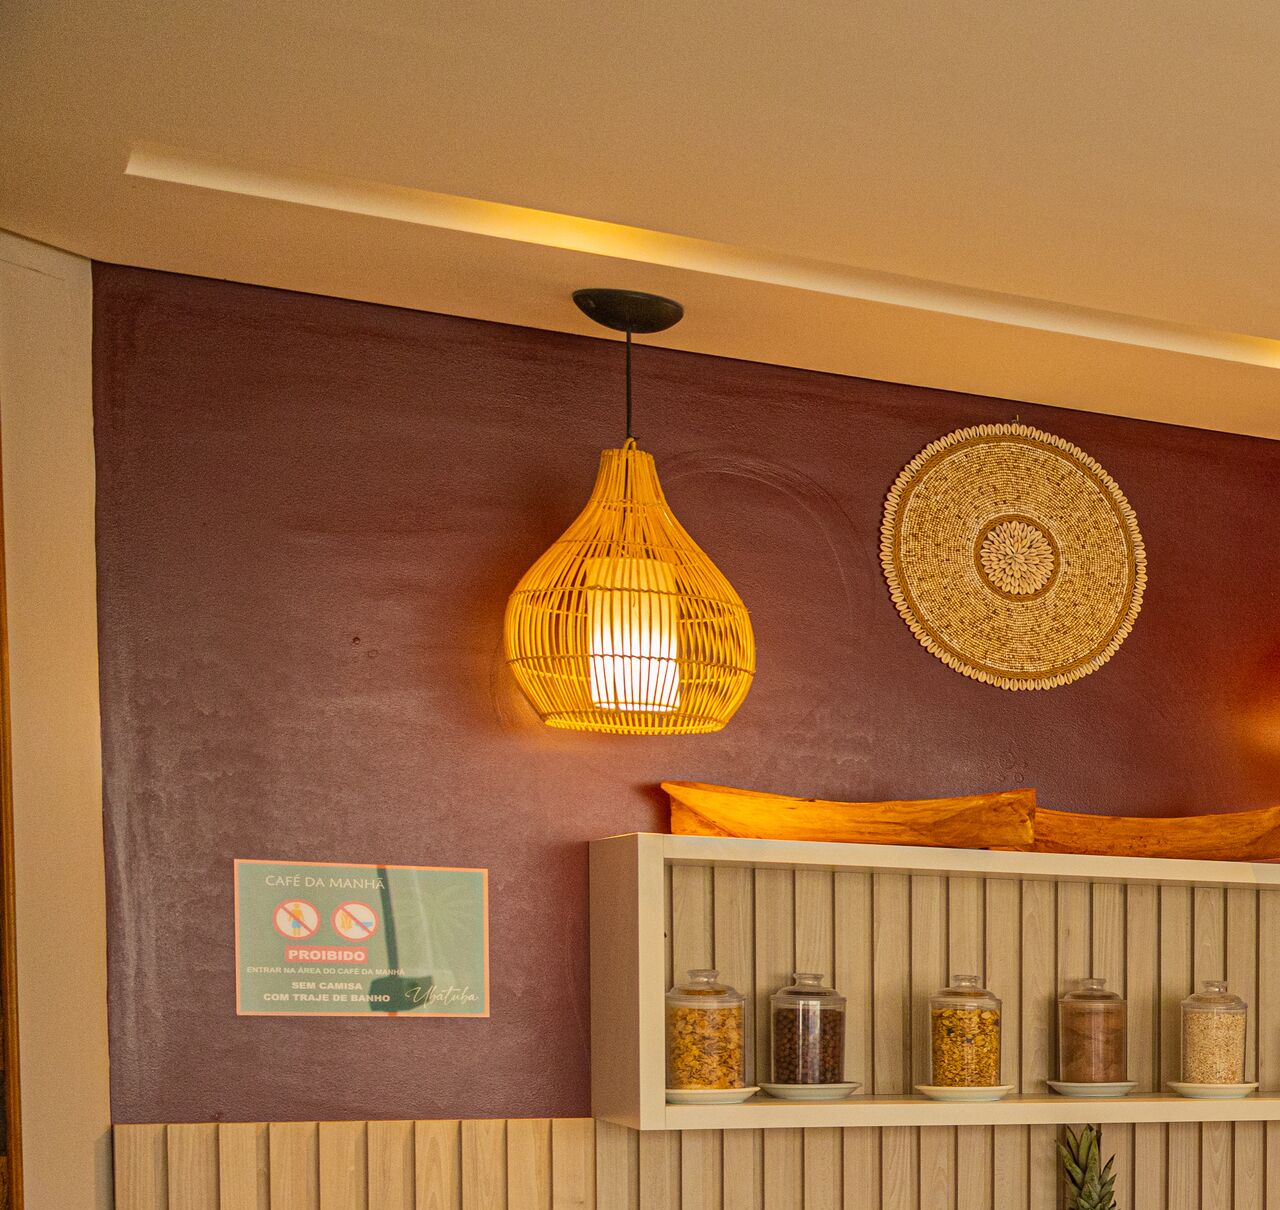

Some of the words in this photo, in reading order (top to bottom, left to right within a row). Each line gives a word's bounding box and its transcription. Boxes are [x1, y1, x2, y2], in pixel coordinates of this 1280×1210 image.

[265, 874, 300, 888] CAFÉ
[304, 877, 326, 888] DA
[328, 877, 386, 890] MANHÃ
[288, 949, 366, 962] PROIBIDO
[247, 966, 282, 974] ENTRAR
[323, 967, 336, 975] DO
[291, 981, 316, 990] SEM
[319, 982, 363, 991] CAMISA
[263, 993, 290, 1002] COM
[293, 993, 329, 1002] TRAJE
[332, 994, 347, 1002] DE
[350, 994, 391, 1003] BANHO
[405, 985, 479, 1009] Ubatuba
